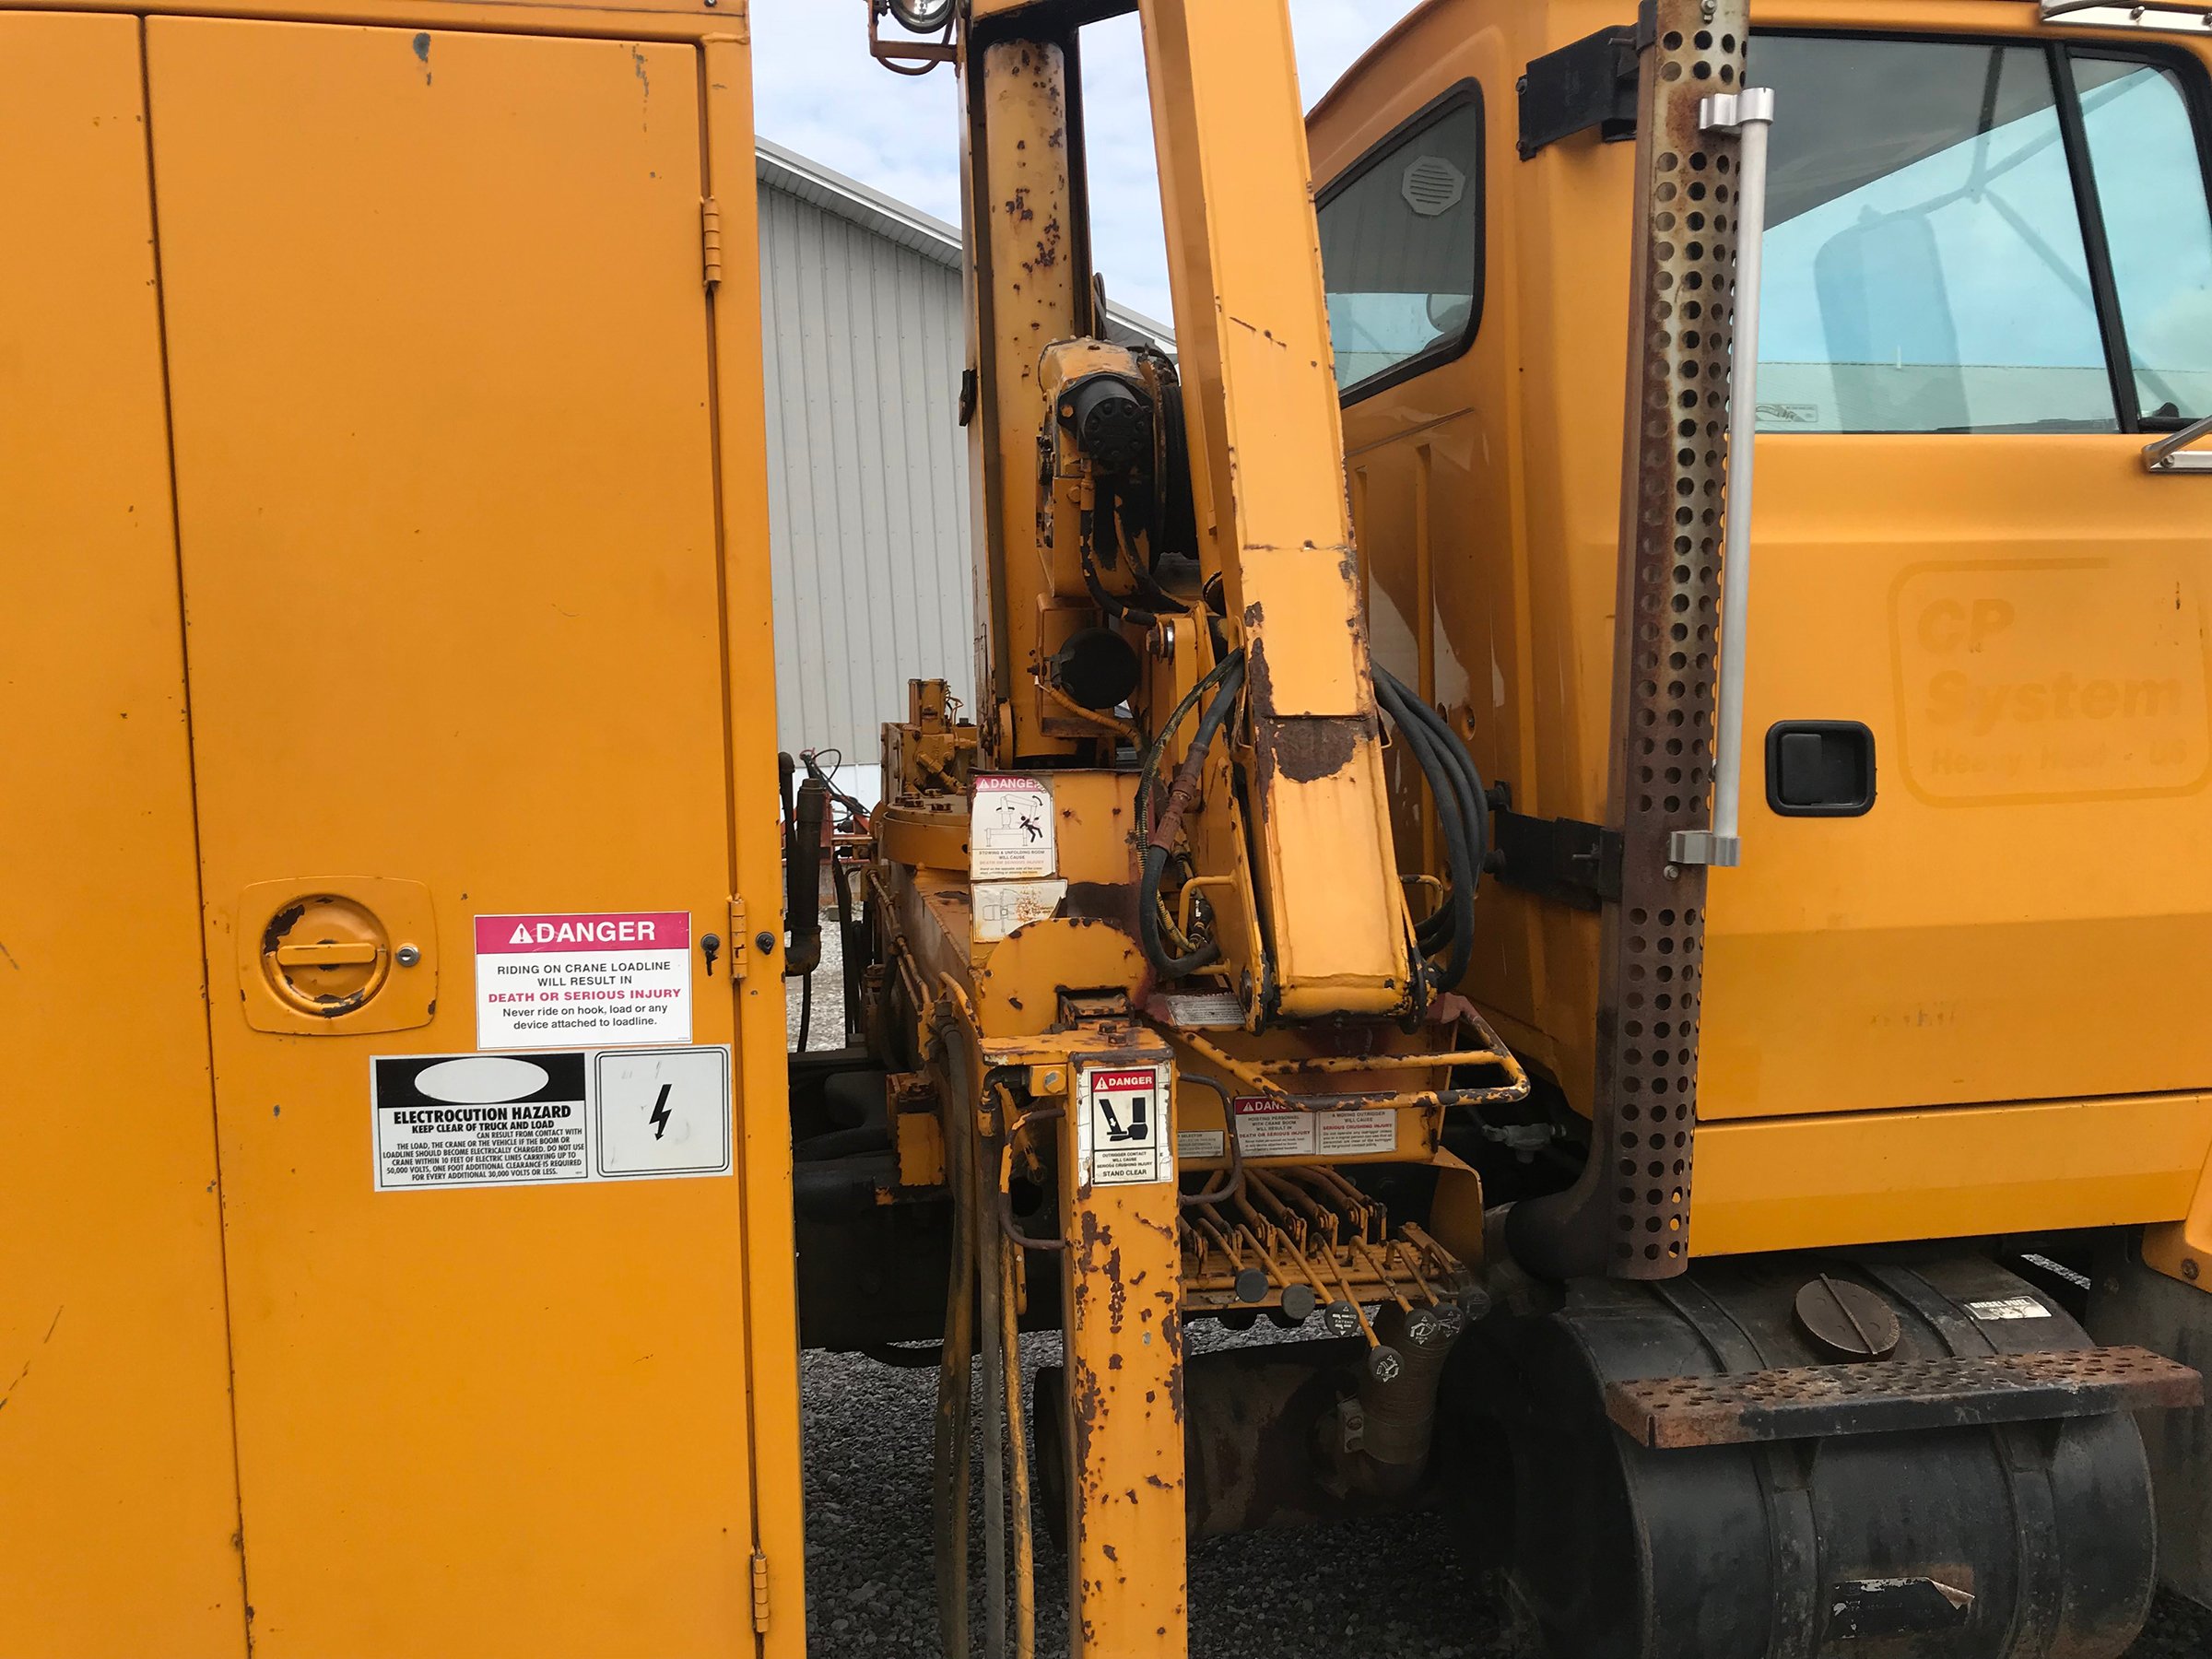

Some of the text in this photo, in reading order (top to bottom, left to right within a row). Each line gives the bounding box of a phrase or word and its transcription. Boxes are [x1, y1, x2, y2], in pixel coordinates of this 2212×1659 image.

[1926, 669, 2183, 737] System
[991, 778, 1037, 788] DANGE
[536, 921, 655, 943] DANGER
[497, 961, 671, 975] RIDING ON CRANE LOADLINE
[537, 975, 632, 986] WILL RESULT IN
[488, 988, 681, 1003] DEATH OR SERIOUS INJURY
[503, 1008, 535, 1017] Never
[538, 1007, 558, 1016] ride
[578, 1005, 607, 1015] hook,
[610, 1004, 632, 1013] load
[648, 1005, 668, 1014] any
[513, 1017, 657, 1030] device attached to loadline.
[1108, 1076, 1152, 1087] DANGER
[1255, 1101, 1287, 1111] DAN
[394, 1105, 571, 1124] ELECTROCUTION HAZARD
[412, 1120, 554, 1134] KEEP CLEAR OF TRUCK AND LOAD
